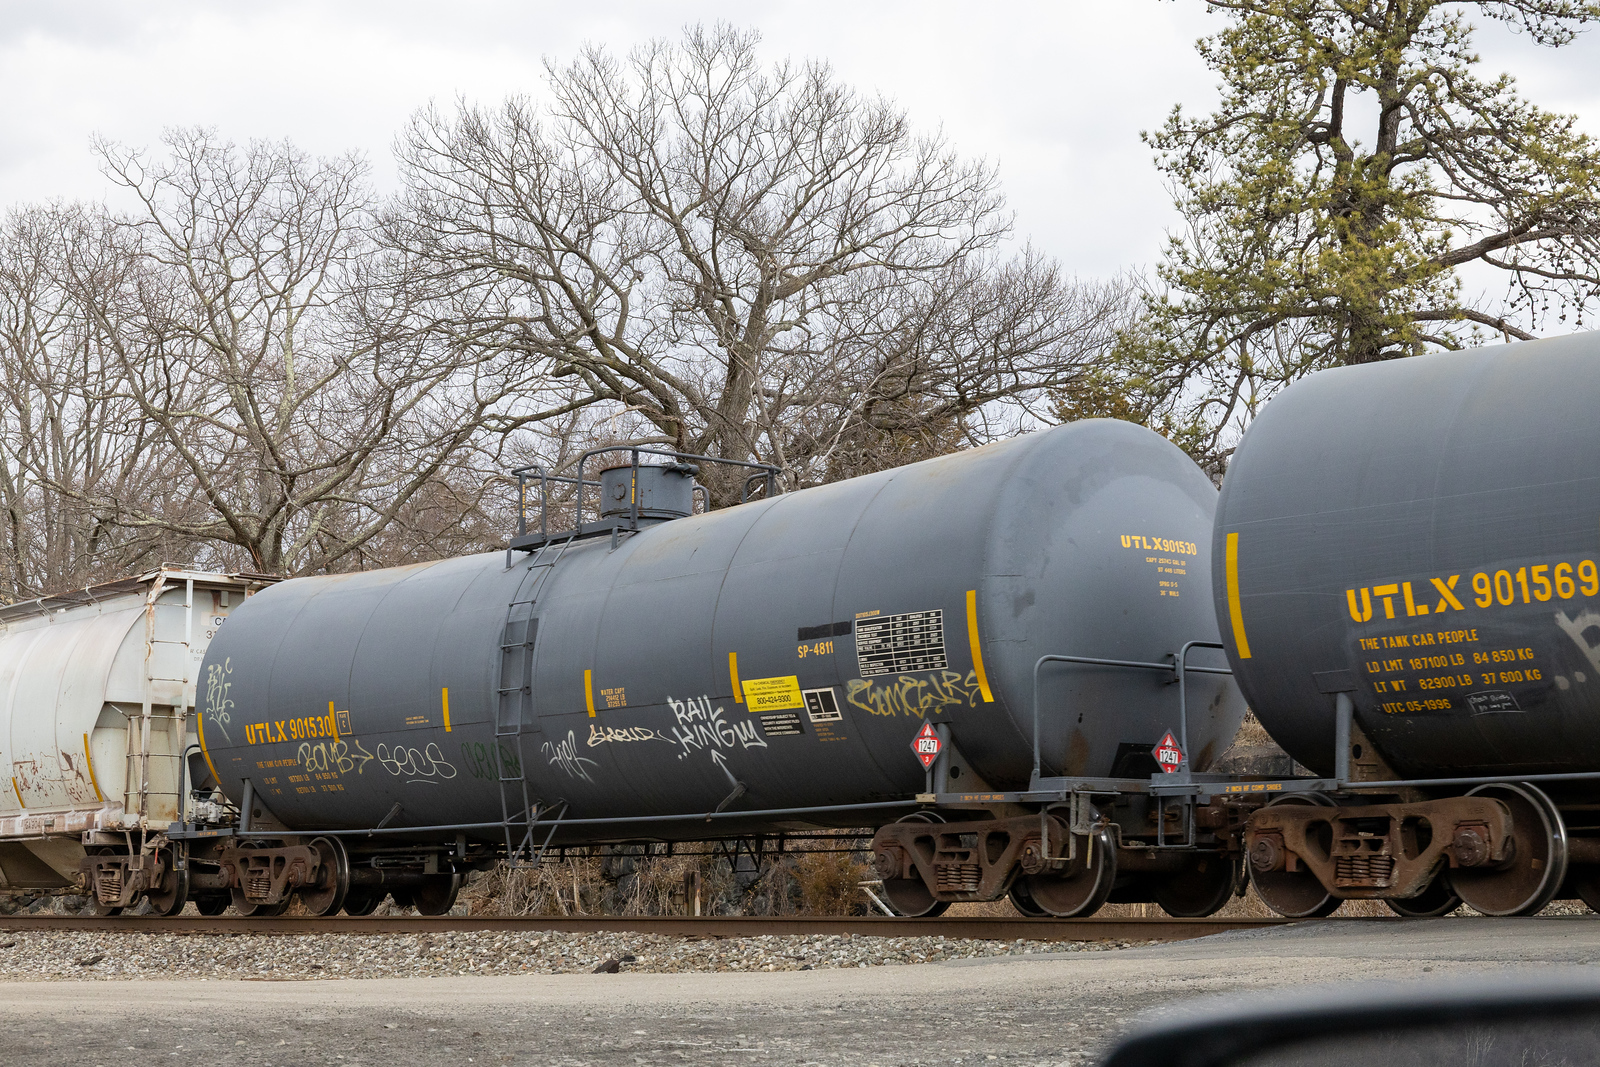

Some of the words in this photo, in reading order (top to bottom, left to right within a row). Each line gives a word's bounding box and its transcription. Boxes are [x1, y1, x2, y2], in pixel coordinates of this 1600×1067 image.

[1346, 575, 1465, 622] UTLX
[1472, 560, 1600, 608] 901569
[798, 641, 834, 658] SP-4811
[1359, 638, 1380, 650] THE
[1382, 635, 1410, 648] TANK
[1412, 633, 1435, 646] CAR
[1437, 629, 1479, 644] PEOPLE
[1366, 661, 1380, 673] LD
[1383, 659, 1404, 672] LMT
[1409, 655, 1448, 670] 187100
[1450, 654, 1465, 665] LB
[1473, 652, 1489, 664] 84
[1492, 649, 1515, 662] 850
[1517, 648, 1534, 660] KG
[1374, 682, 1387, 693] LT
[1391, 680, 1406, 691] WT
[1419, 676, 1456, 689] 82900
[1457, 674, 1473, 686] LB
[1481, 673, 1496, 684] 37
[1500, 670, 1523, 683] 600
[1525, 669, 1542, 681] KG
[667, 694, 724, 725] RAIL
[1383, 702, 1405, 713] UTC
[1406, 698, 1451, 711] 05-1996
[245, 721, 288, 744] UTLX
[289, 715, 333, 739] 901530
[671, 719, 735, 753] KING
[920, 740, 936, 752] 1247
[1161, 751, 1177, 764] 1247
